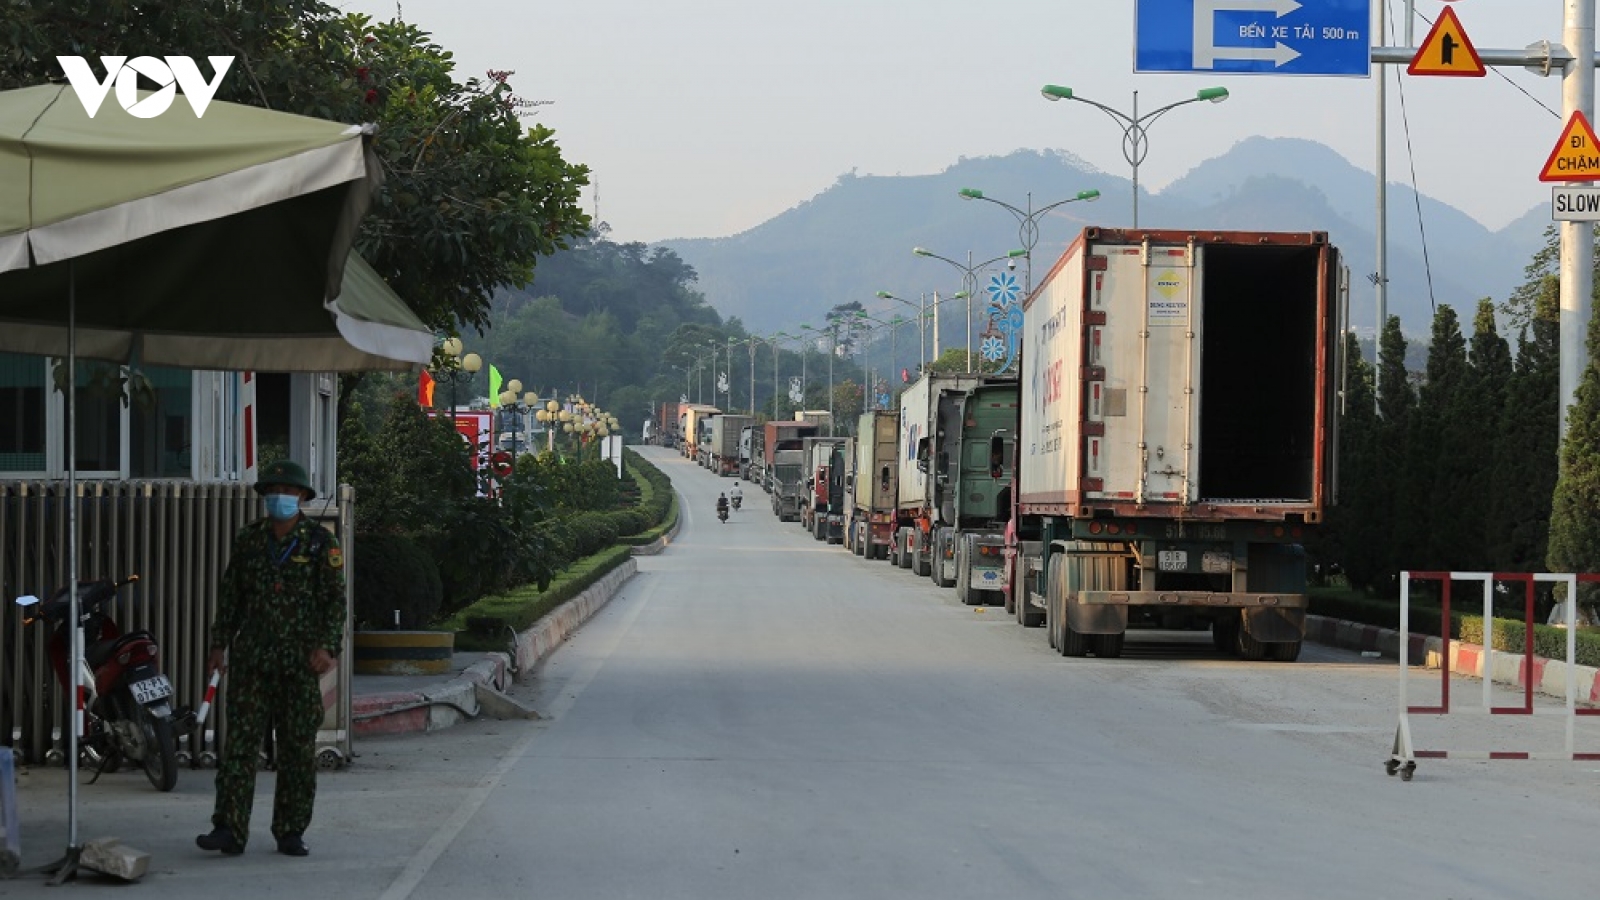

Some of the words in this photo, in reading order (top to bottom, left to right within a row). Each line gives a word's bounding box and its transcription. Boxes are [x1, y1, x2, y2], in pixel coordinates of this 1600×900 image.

[1239, 21, 1265, 38] BẾN
[1271, 26, 1289, 38] XE
[1293, 23, 1315, 39] TẢI
[1322, 27, 1344, 40] 500
[1346, 31, 1359, 40] m
[1571, 136, 1585, 149] ĐI
[1557, 154, 1600, 172] CHẬM
[1556, 194, 1600, 213] SLOW
